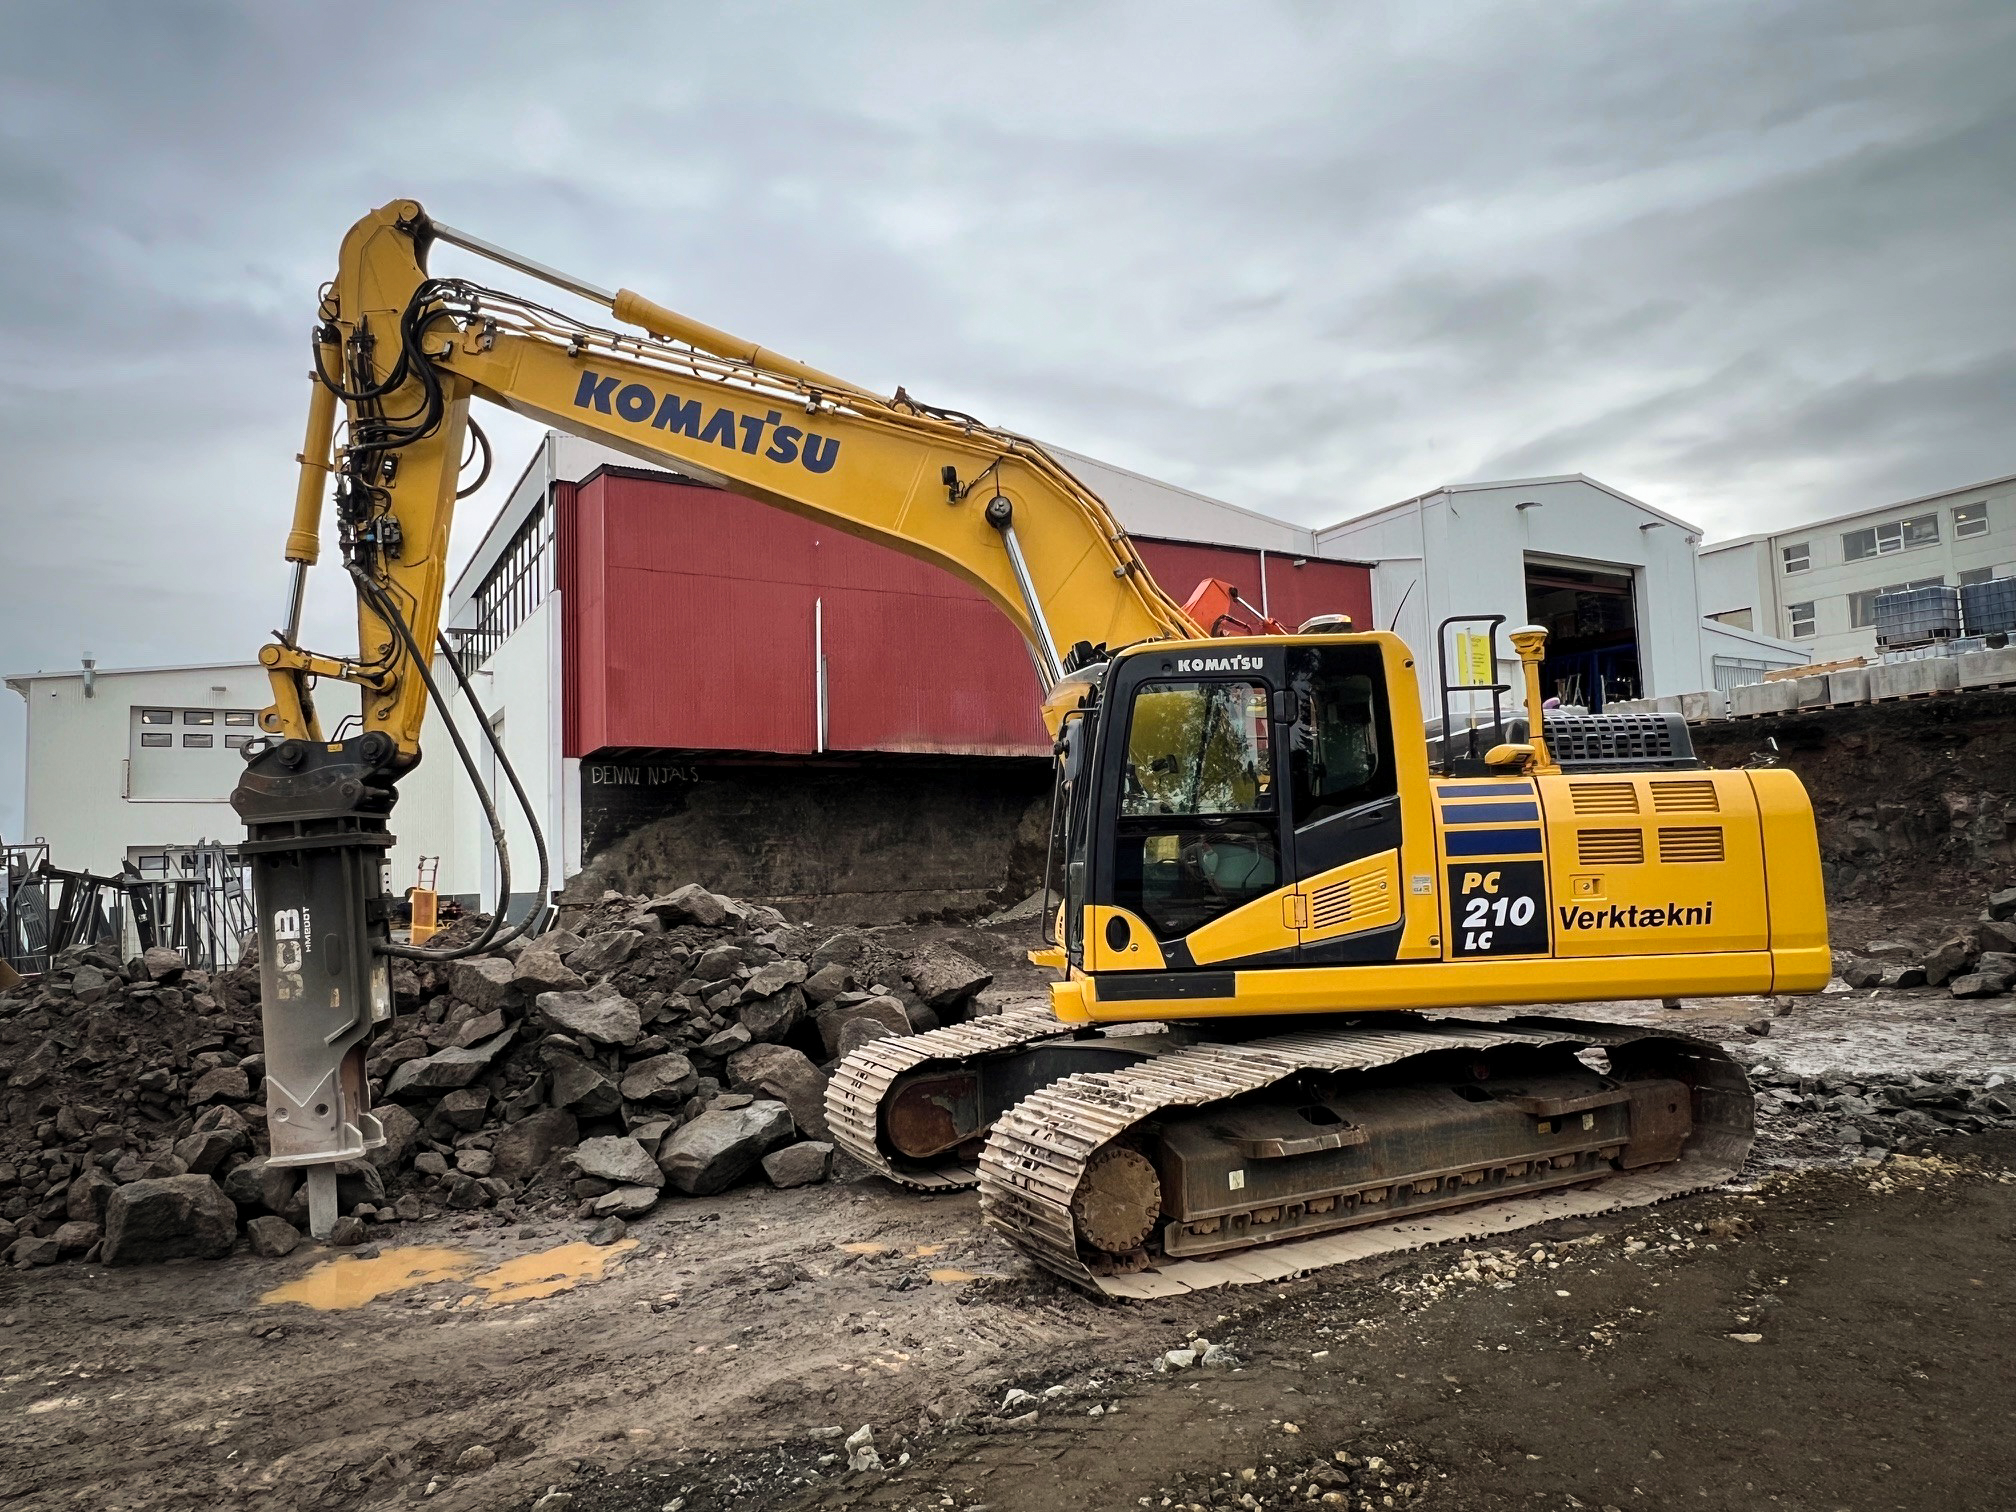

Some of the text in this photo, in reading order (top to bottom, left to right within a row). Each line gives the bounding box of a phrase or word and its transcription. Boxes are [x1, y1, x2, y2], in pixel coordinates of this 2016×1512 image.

[574, 369, 841, 474] KOMATSU
[1177, 654, 1264, 672] KOMATSU
[1461, 871, 1502, 895] PC
[1461, 896, 1536, 928] 210
[1559, 901, 1713, 931] Verktækni
[1464, 931, 1494, 950] LC
